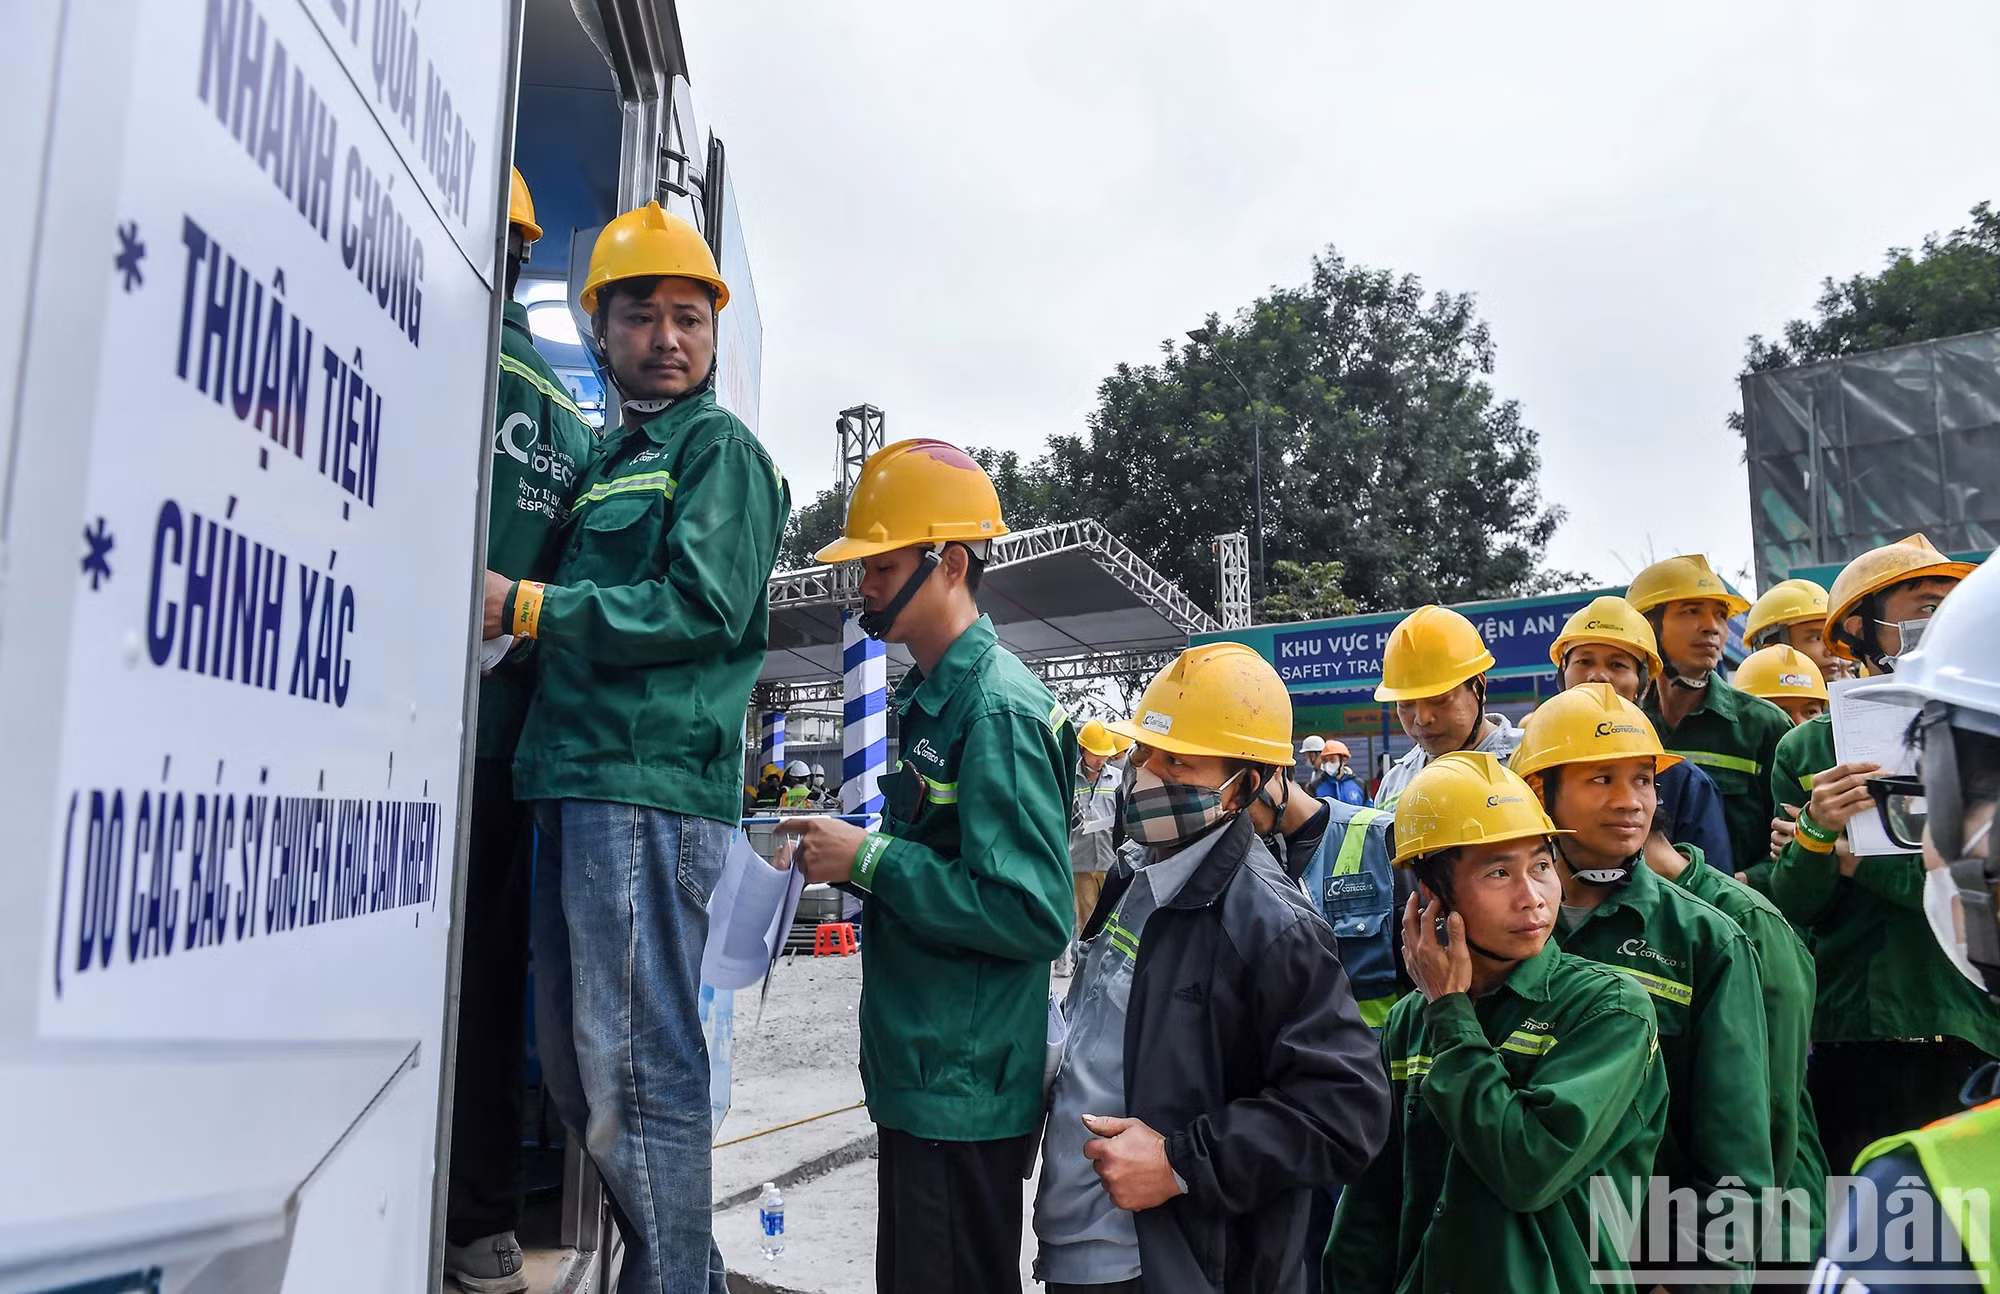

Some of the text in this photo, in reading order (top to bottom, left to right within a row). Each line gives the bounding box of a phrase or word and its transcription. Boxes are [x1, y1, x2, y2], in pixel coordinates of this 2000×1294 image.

[198, 0, 424, 349] NHANH CHÓNG
[176, 213, 382, 521] THUẬN TIỆN
[147, 495, 355, 708] CHÍNH XÁC
[1281, 638, 1322, 658] KHU
[1327, 632, 1369, 657] VỰC
[1522, 615, 1555, 636] AN
[1281, 658, 1384, 680] SAFETY TRA
[129, 754, 184, 964] CÁC
[184, 758, 235, 951] BÁC
[267, 769, 334, 935] CHUYÊN
[331, 797, 371, 919] KHOA
